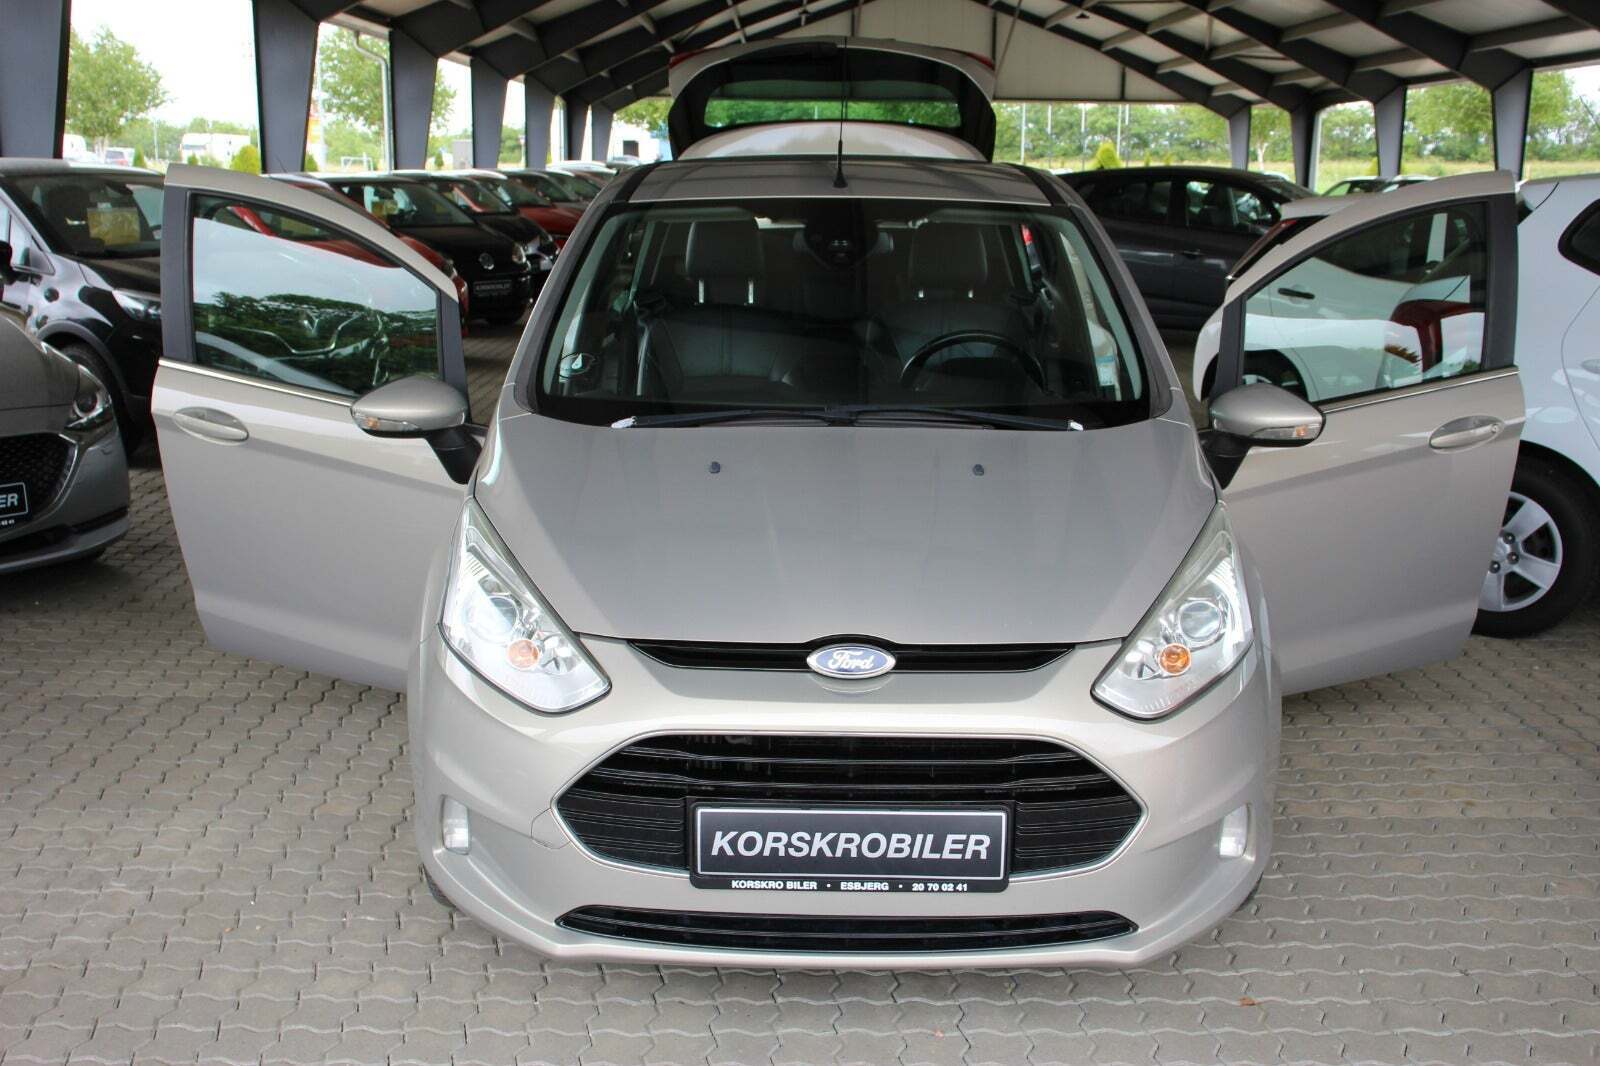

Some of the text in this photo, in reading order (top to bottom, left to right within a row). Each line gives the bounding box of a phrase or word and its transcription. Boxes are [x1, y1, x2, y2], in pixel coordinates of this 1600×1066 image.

[828, 650, 874, 669] Ford
[711, 831, 991, 860] KORSKROBILER
[731, 880, 968, 892] KORSKRO BILER ESBJERG 20 70 02 41
